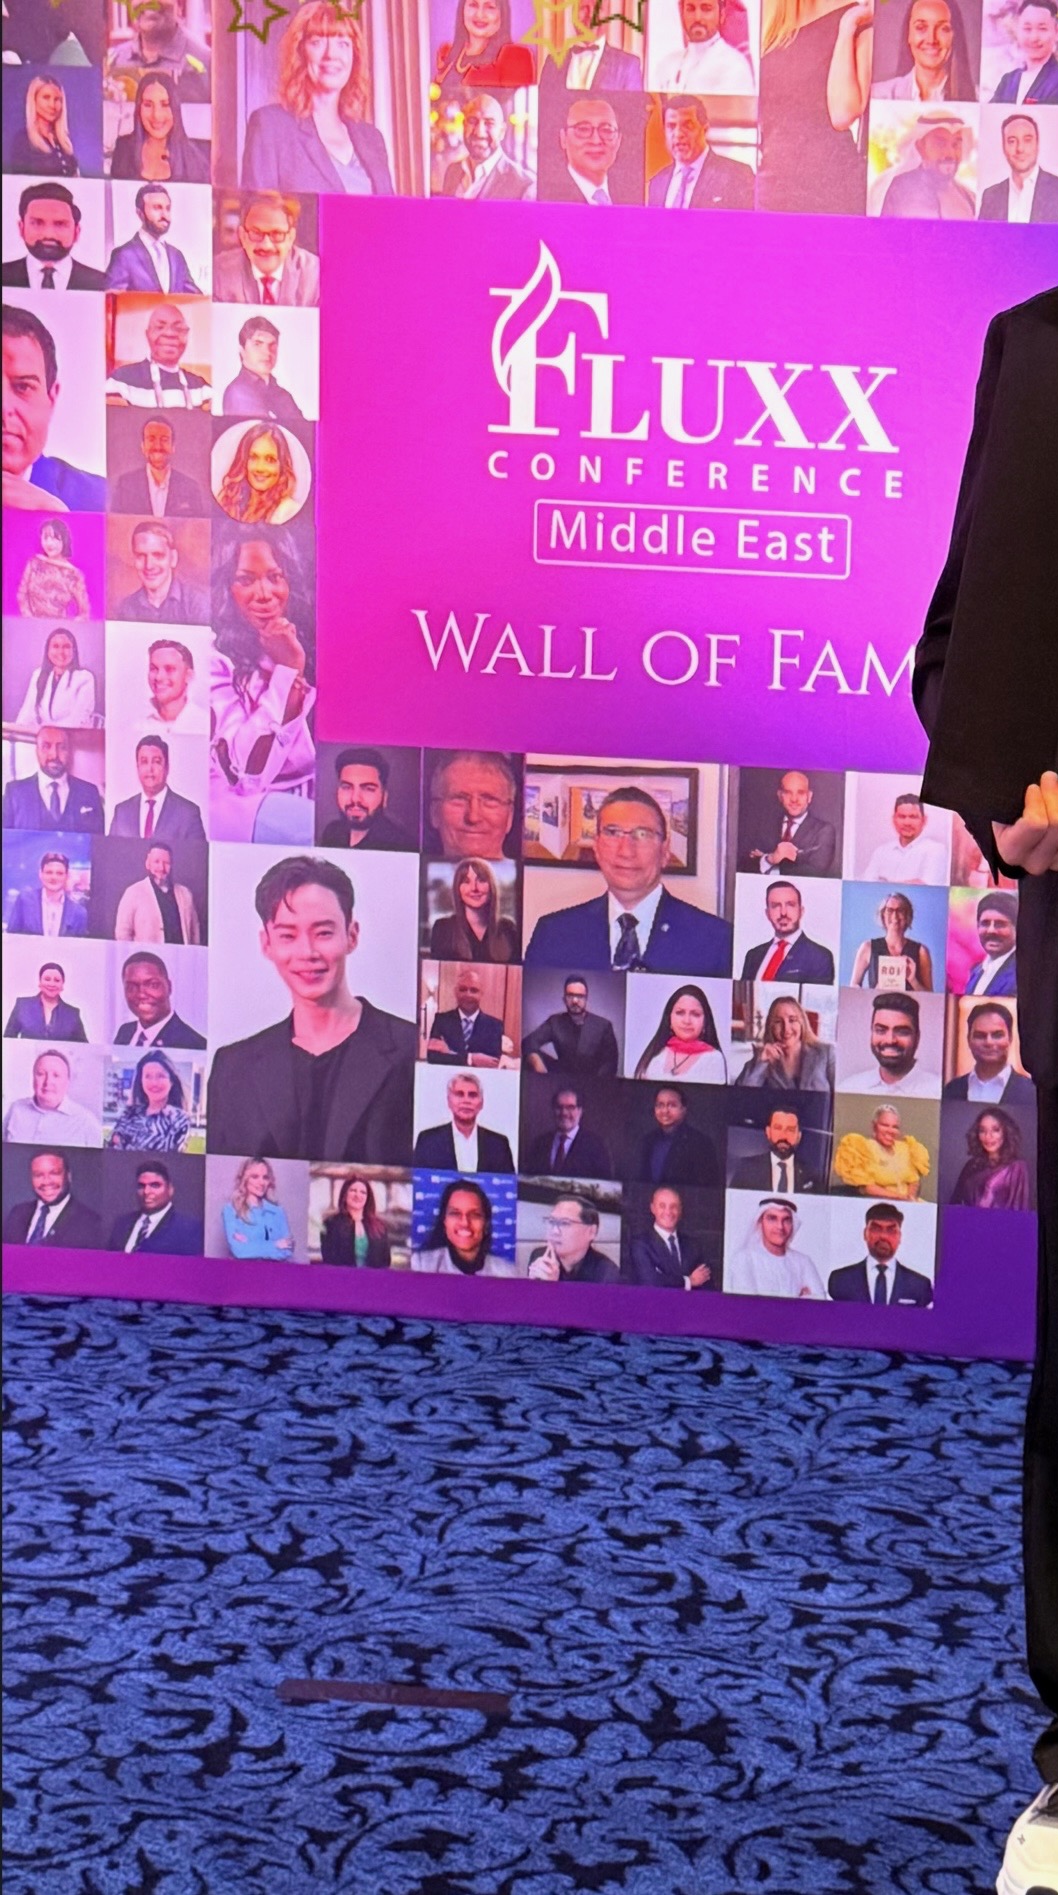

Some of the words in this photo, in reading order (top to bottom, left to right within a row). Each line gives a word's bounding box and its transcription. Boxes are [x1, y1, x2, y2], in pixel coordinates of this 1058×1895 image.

[488, 270, 900, 454] FLUXX
[488, 450, 903, 498] CONFERENCE
[550, 509, 717, 558] Middle
[737, 519, 836, 564] East
[411, 609, 618, 681] WALL
[642, 630, 741, 687] OF
